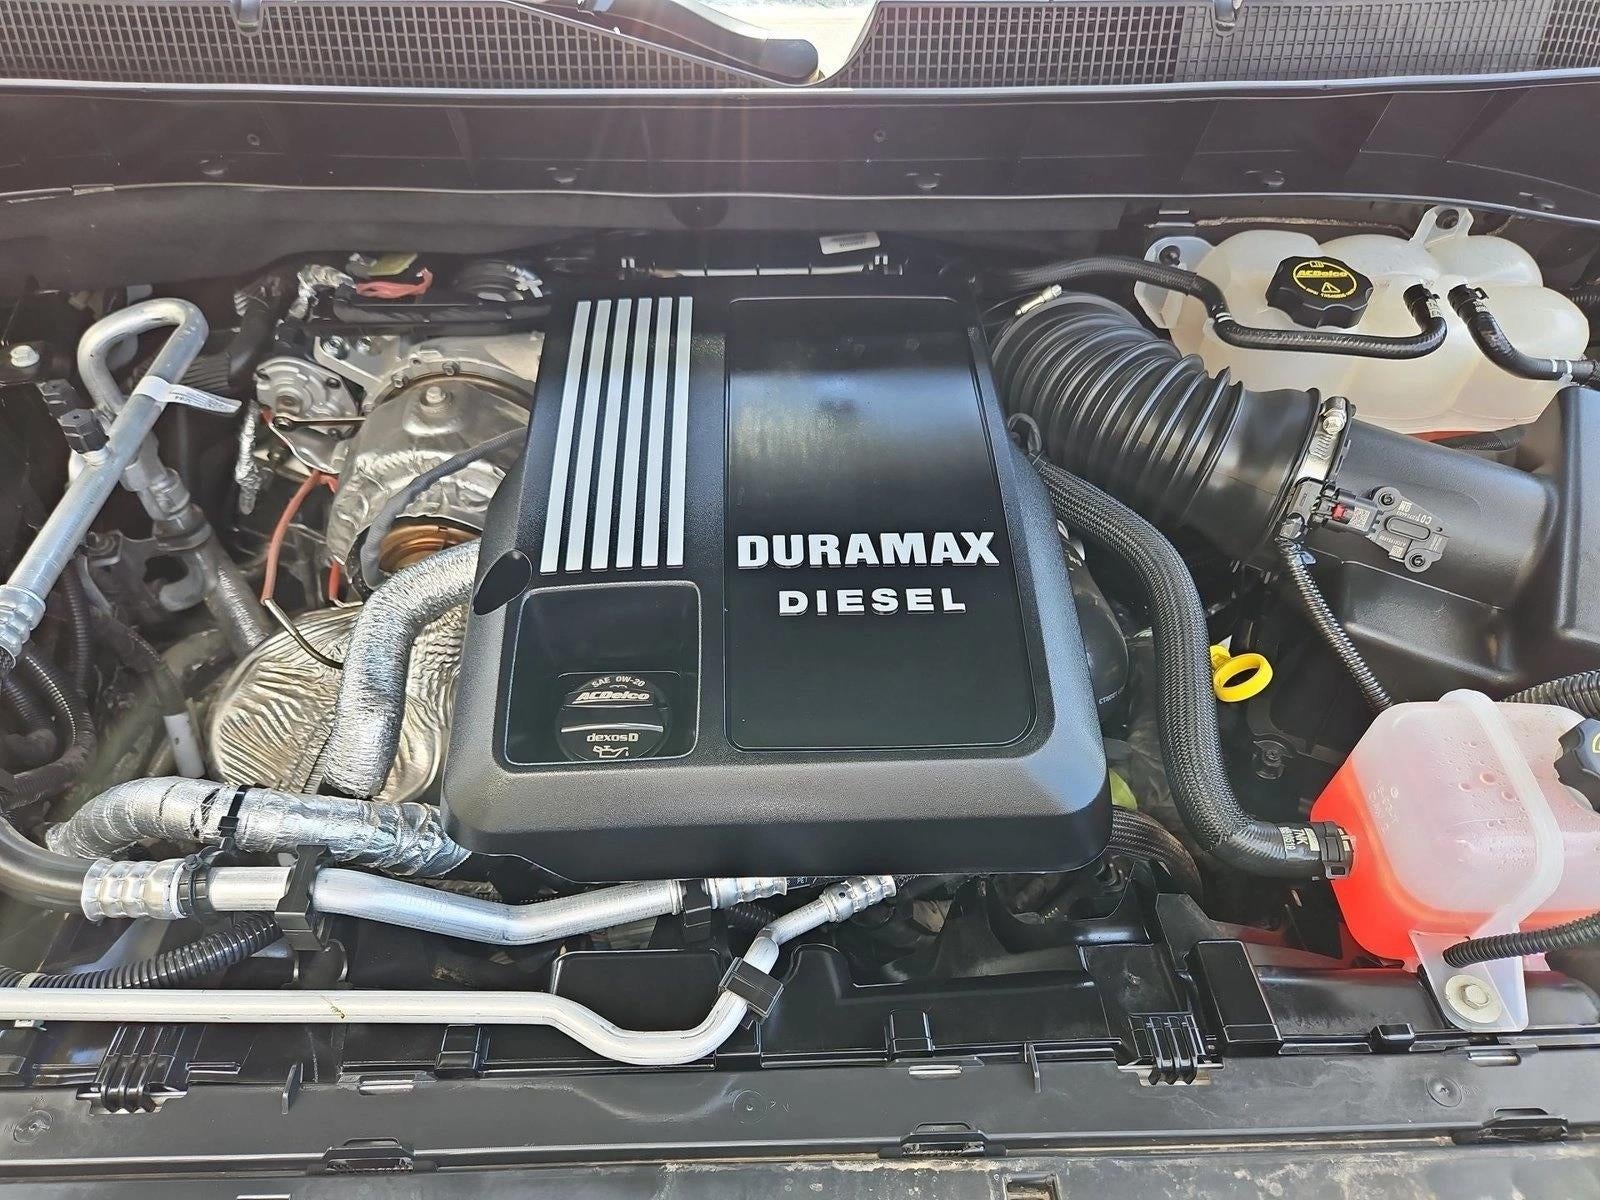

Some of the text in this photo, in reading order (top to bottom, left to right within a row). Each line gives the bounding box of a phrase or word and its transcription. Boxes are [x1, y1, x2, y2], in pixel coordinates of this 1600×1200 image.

[1296, 265, 1348, 278] ACDelco
[737, 531, 1000, 569] DURAMAX
[778, 587, 966, 615] DIESEL
[591, 675, 646, 688] SAE 0W-20
[574, 690, 650, 703] ACDelco
